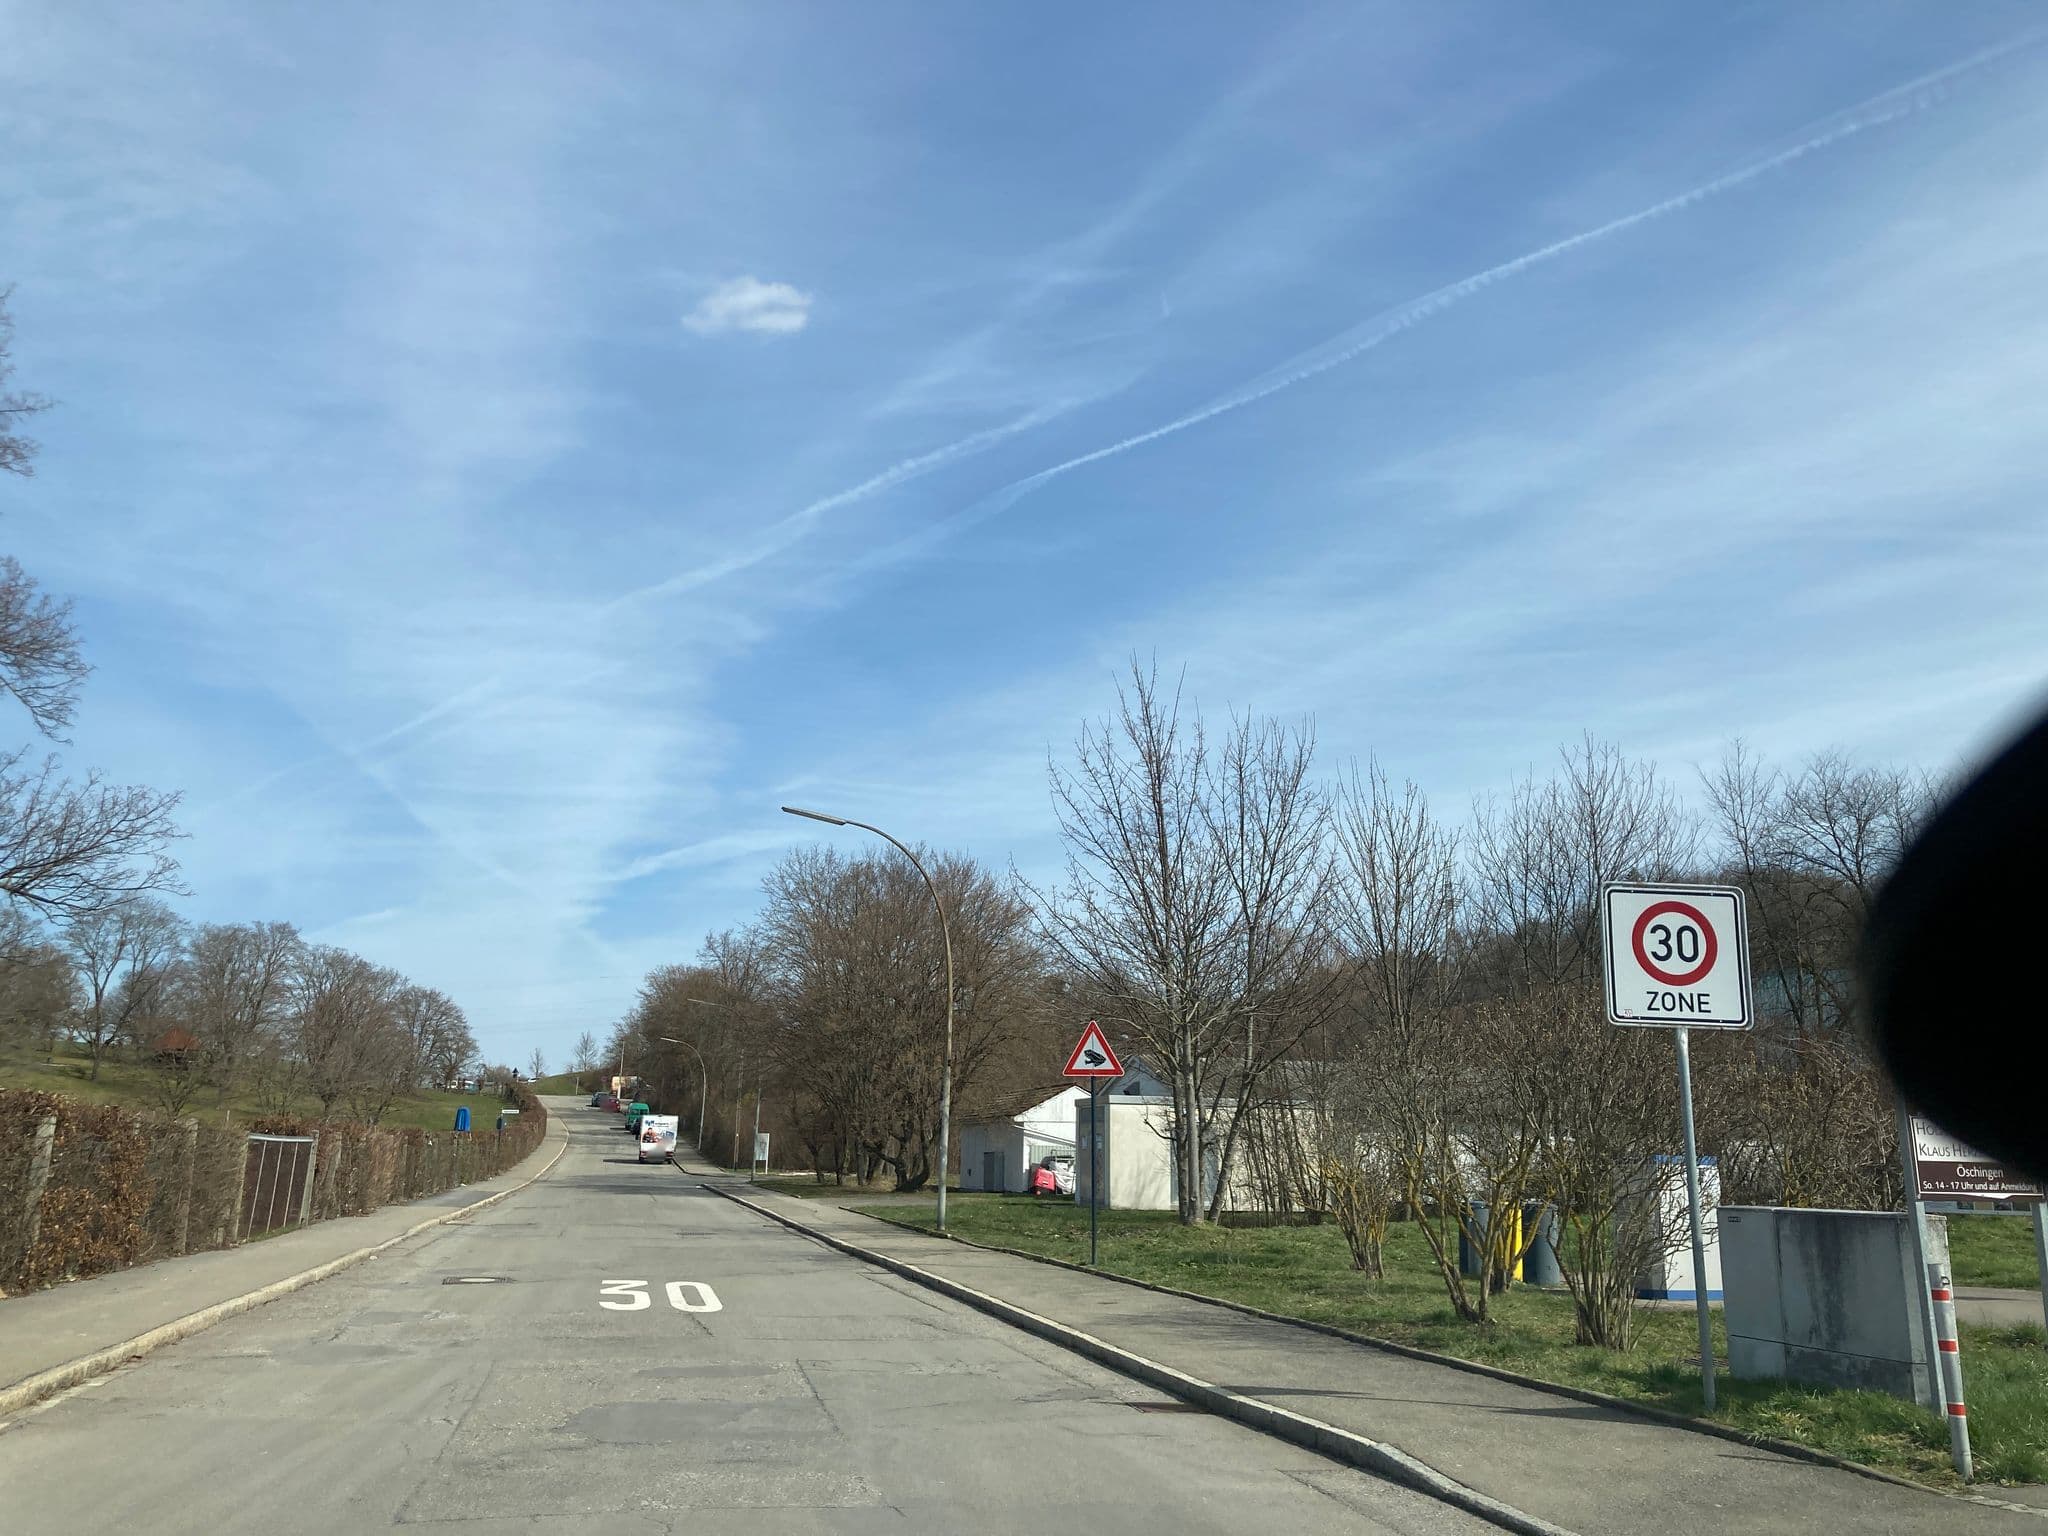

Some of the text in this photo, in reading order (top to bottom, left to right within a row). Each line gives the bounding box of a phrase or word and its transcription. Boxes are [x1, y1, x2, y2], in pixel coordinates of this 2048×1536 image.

[1650, 924, 1699, 963] 30
[1646, 991, 1712, 1013] ZONE
[1918, 1143, 1951, 1157] KLAUS
[1935, 1182, 1945, 1190] 14
[1951, 1181, 1959, 1190] 17
[1961, 1182, 1974, 1190] Uhr
[1975, 1182, 1988, 1190] und
[1989, 1182, 2000, 1191] auf
[599, 1280, 723, 1312] 30
